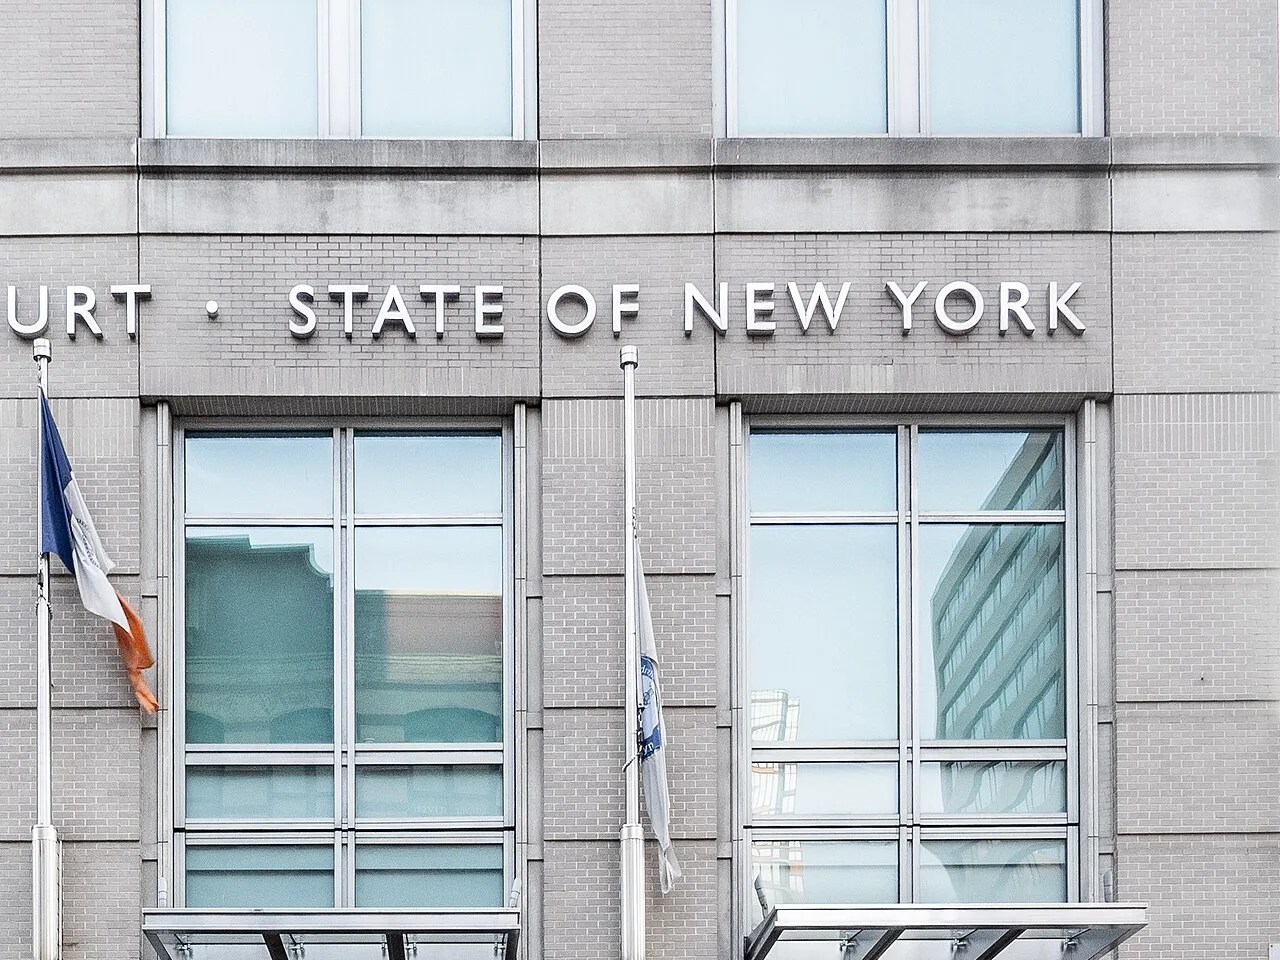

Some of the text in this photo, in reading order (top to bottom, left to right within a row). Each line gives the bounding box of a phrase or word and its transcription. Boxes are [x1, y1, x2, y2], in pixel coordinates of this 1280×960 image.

[288, 283, 505, 339] STATE
[546, 282, 640, 339] OF
[684, 281, 852, 338] NEW
[884, 279, 1086, 337] YORK
